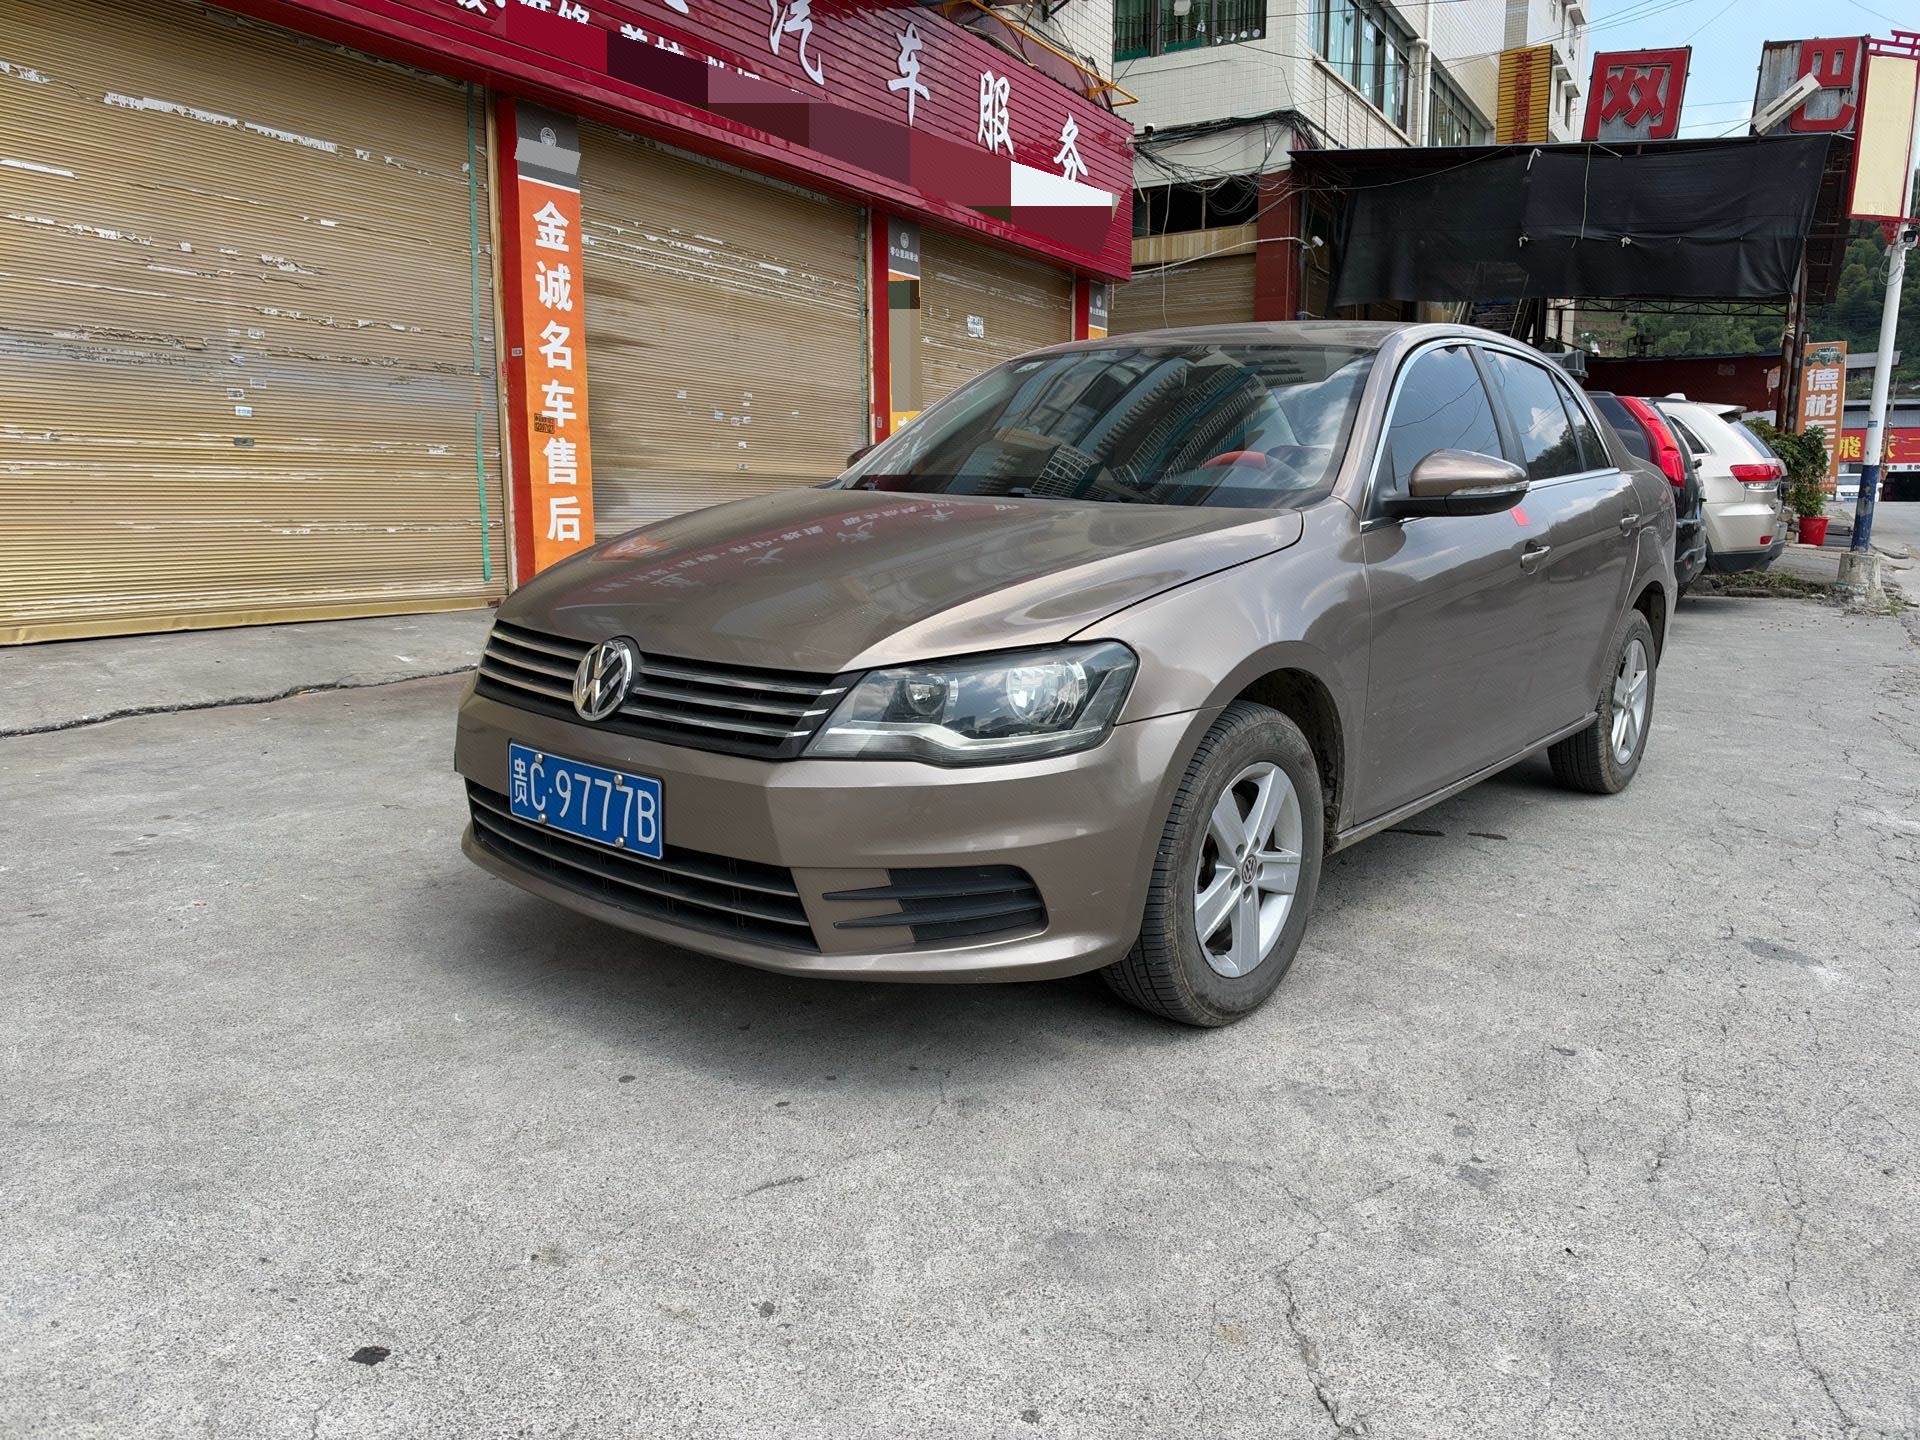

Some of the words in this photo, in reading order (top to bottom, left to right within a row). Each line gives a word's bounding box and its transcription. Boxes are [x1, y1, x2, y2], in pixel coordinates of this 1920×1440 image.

[658, 0, 1089, 183] 汽车服务
[533, 201, 581, 541] 金诚名车售后
